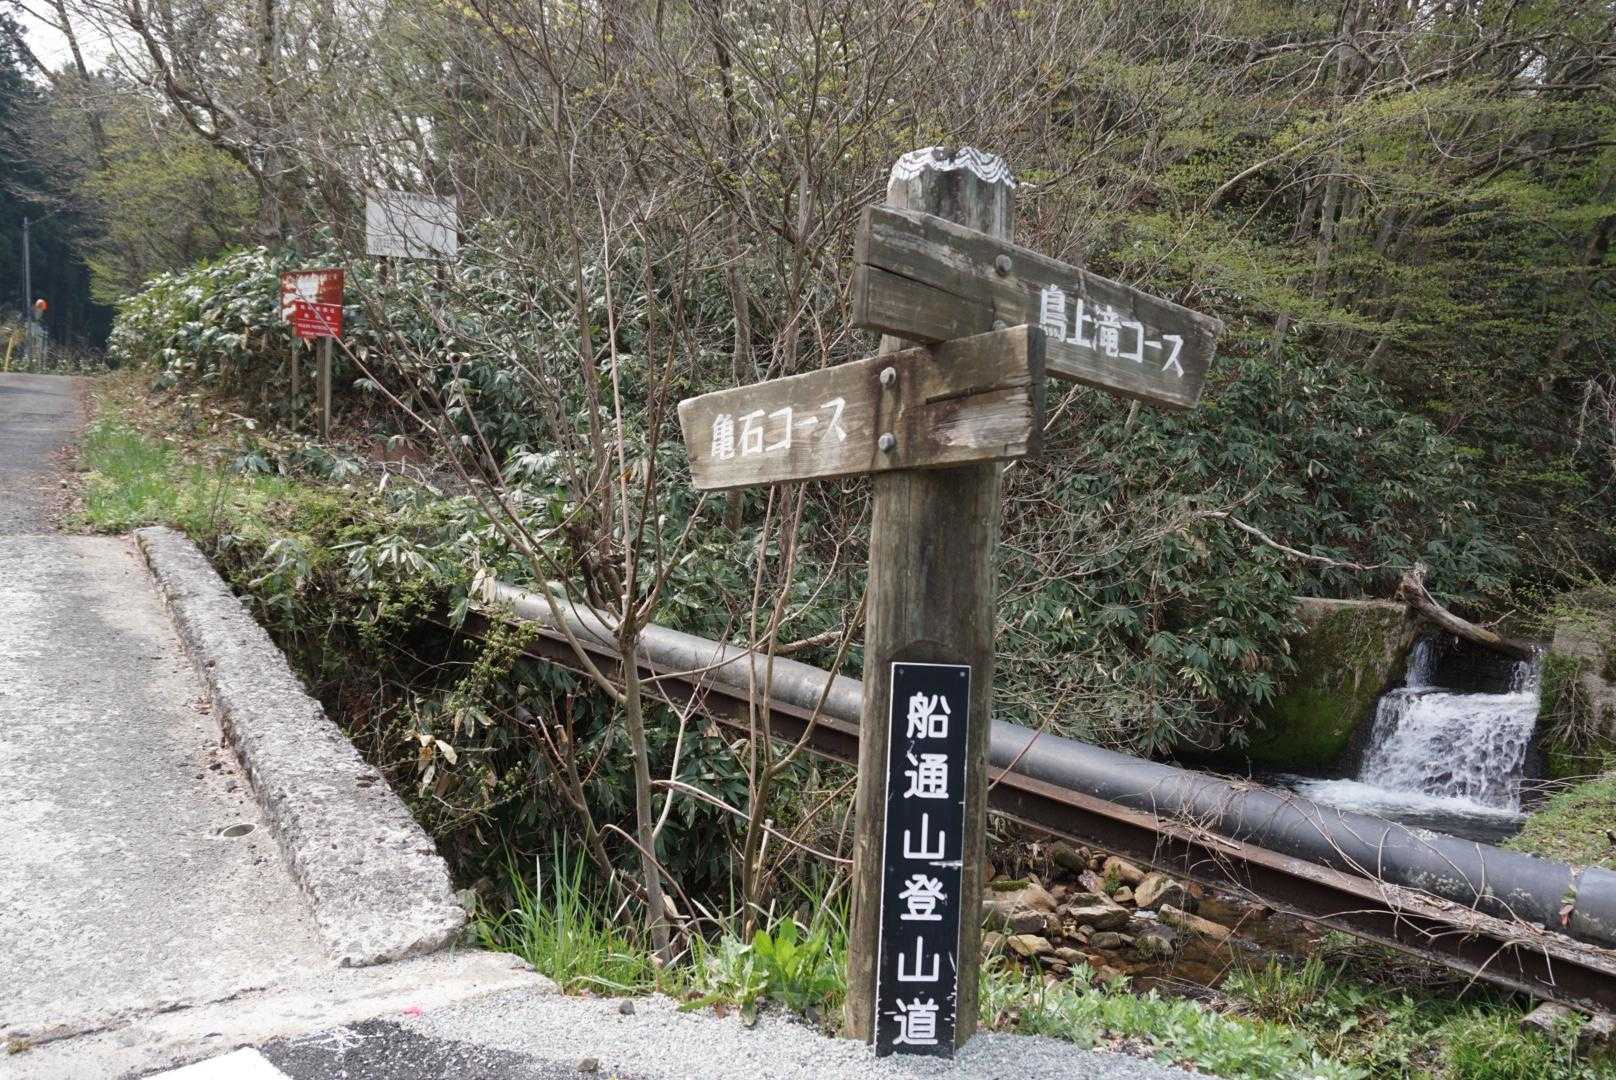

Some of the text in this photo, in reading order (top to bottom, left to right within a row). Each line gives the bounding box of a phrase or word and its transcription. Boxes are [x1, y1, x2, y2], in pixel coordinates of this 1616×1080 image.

[1039, 284, 1185, 378] 鳥上滝コース
[710, 396, 848, 461] 亀石コース
[892, 691, 952, 1045] 船通山登山道
